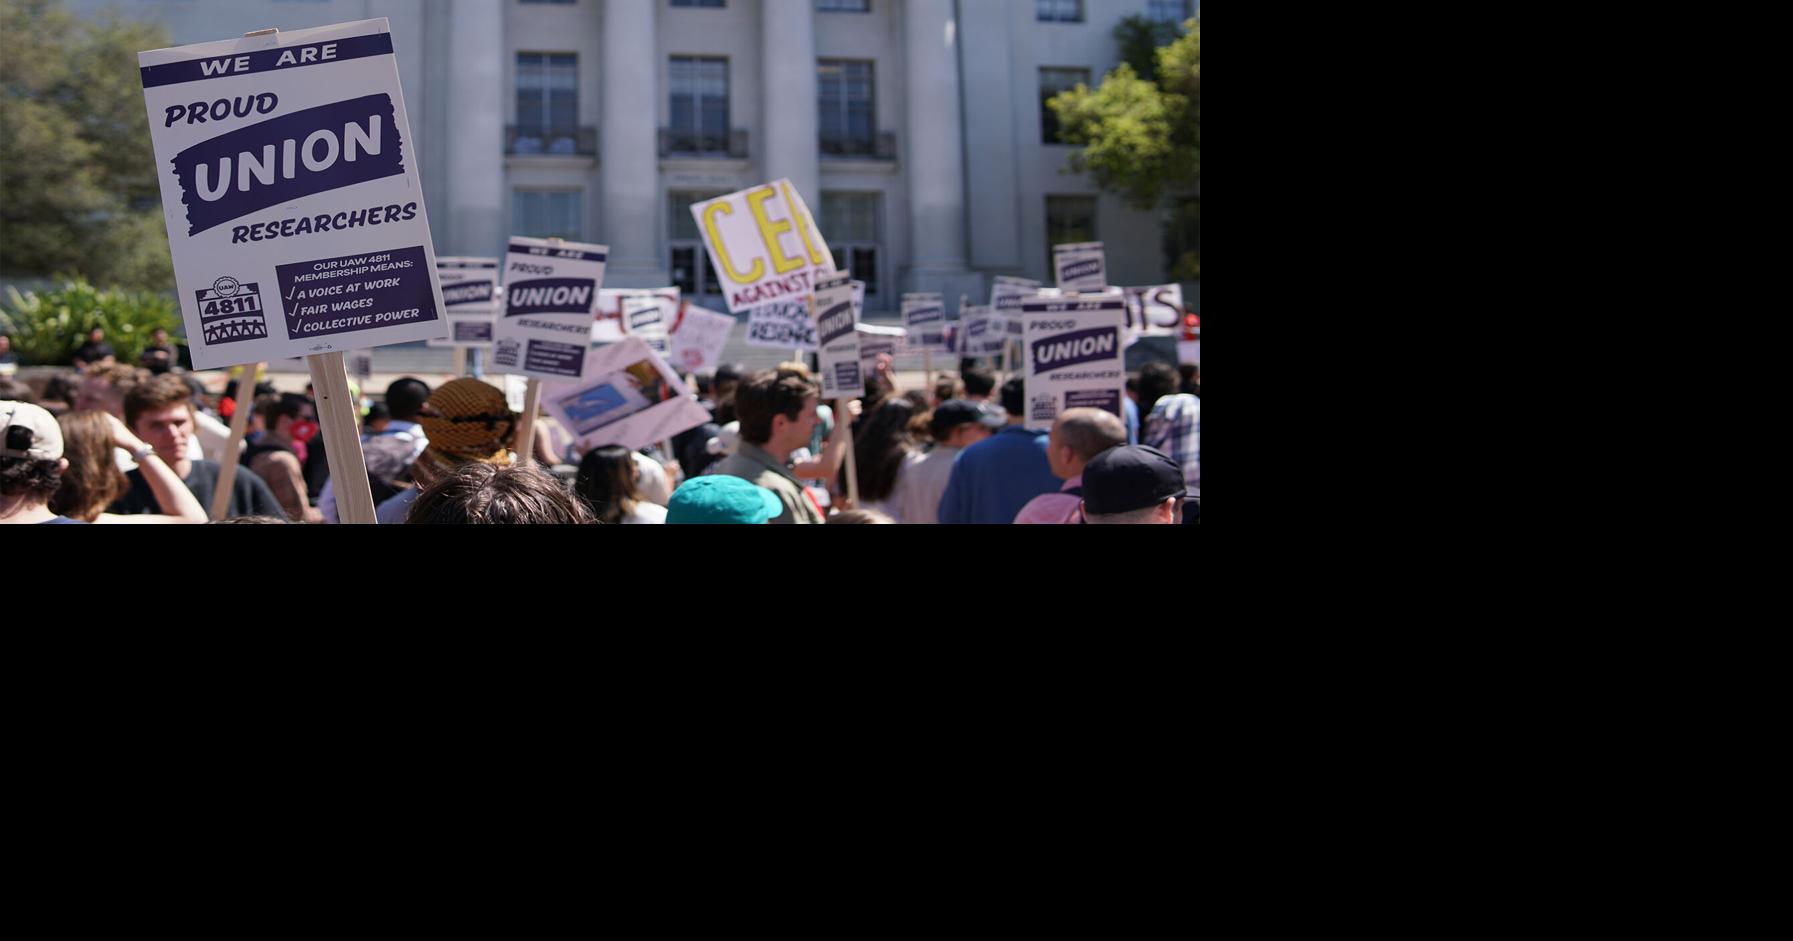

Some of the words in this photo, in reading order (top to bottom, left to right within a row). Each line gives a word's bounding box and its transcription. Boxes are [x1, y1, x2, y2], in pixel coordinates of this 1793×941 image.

[200, 56, 250, 77] WE
[276, 44, 337, 67] ARE
[165, 92, 278, 127] PROUD
[195, 115, 382, 202] UNION
[232, 202, 417, 244] RESEARCHERS
[294, 265, 369, 283] MEMBERSHIP
[370, 260, 413, 273] MEANS:
[313, 261, 338, 271] OUR
[339, 257, 368, 268] UAW
[368, 253, 391, 263] 4811
[511, 262, 554, 275] PROUD
[218, 283, 235, 291] UAW
[297, 289, 306, 299] A
[308, 285, 342, 298] VOICE
[346, 282, 362, 293] AT
[364, 277, 401, 291] WORK
[511, 286, 590, 307] UNION
[733, 271, 812, 307] AGAINST
[204, 296, 256, 316] 4811
[301, 304, 328, 316] FAIR
[331, 298, 374, 311] WAGES
[303, 314, 371, 333] COLLECTIVE
[375, 308, 420, 323] POWER
[1030, 319, 1076, 331] PROUD
[1037, 333, 1114, 364] UNION
